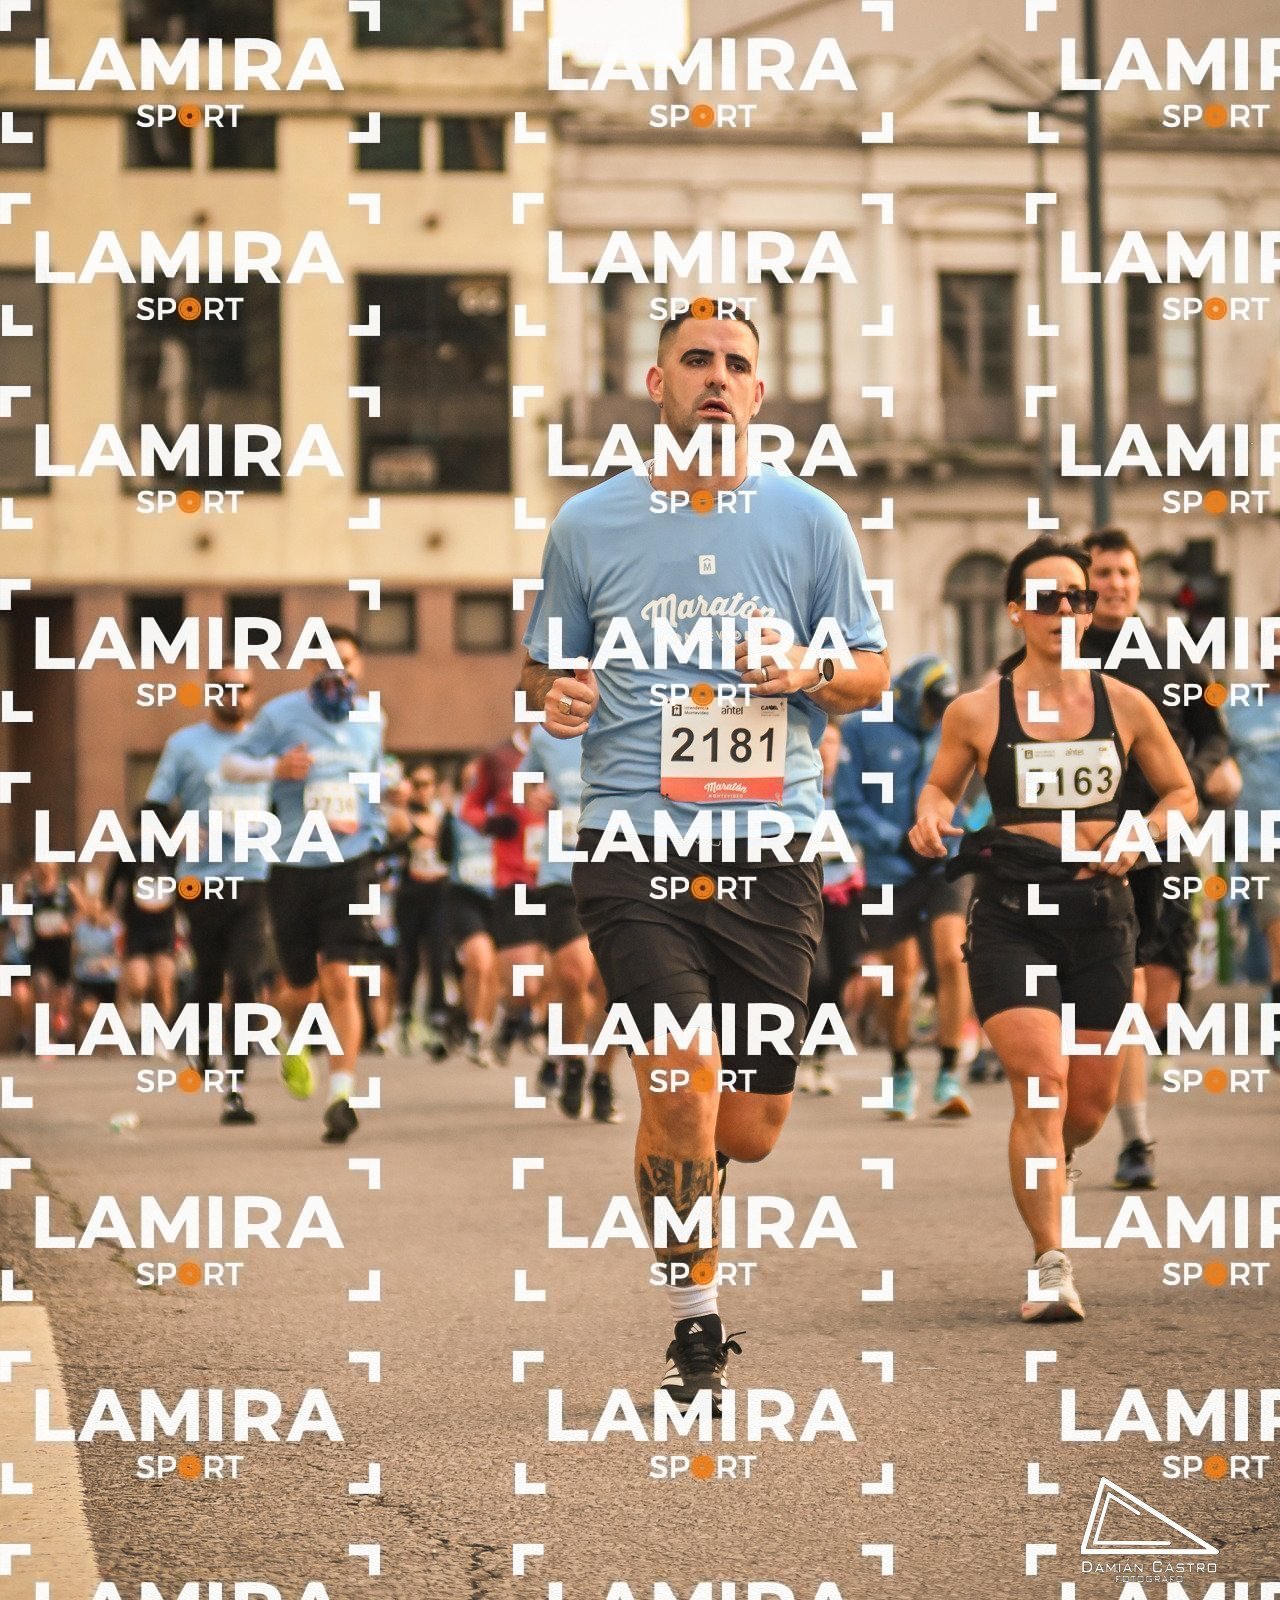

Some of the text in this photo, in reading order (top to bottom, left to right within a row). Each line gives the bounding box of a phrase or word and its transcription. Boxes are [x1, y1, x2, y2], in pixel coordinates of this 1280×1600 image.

[721, 705, 744, 715] antel
[671, 727, 774, 763] 2181
[703, 781, 748, 794] Maratón
